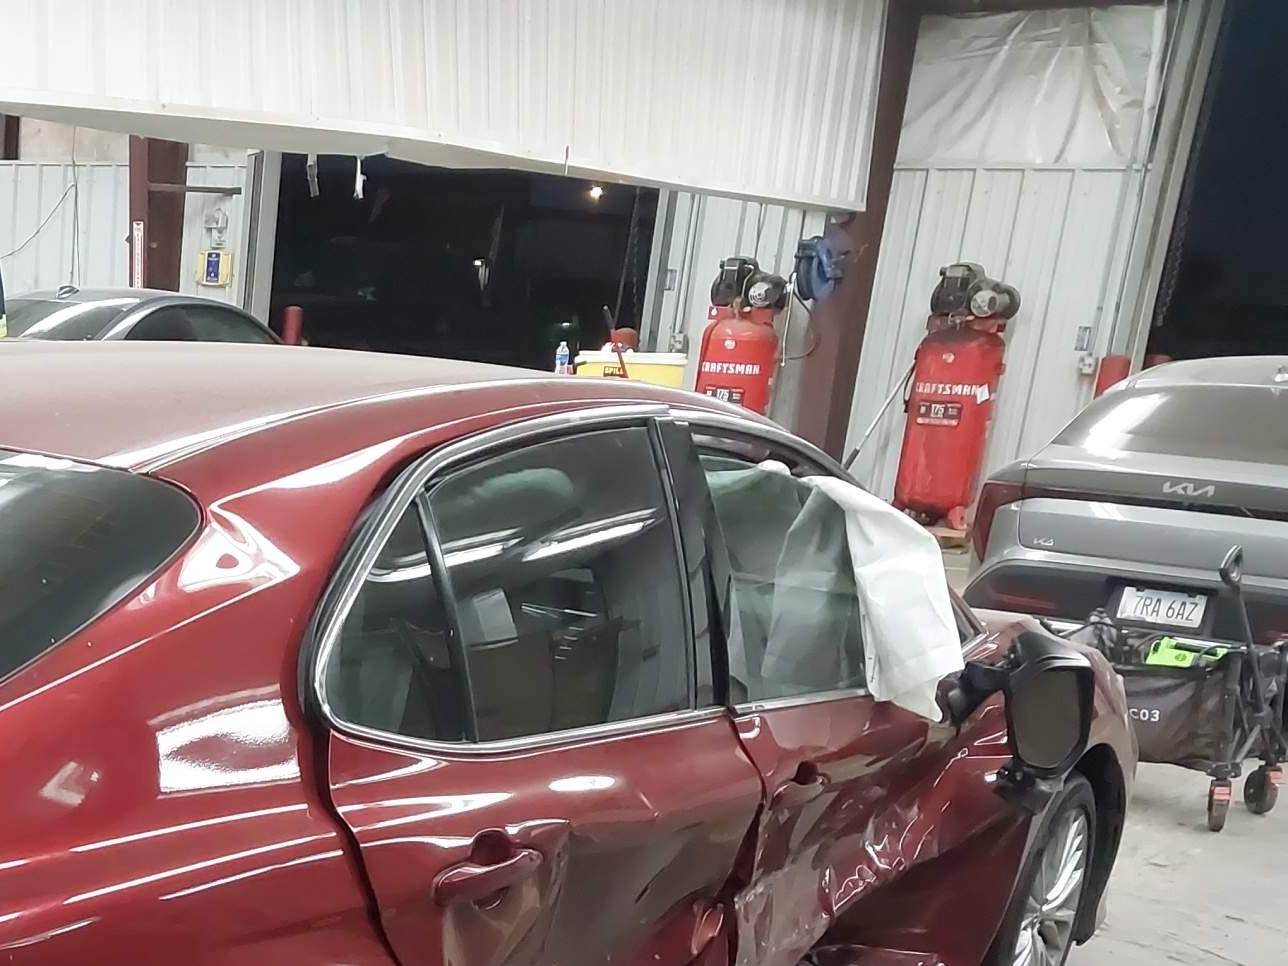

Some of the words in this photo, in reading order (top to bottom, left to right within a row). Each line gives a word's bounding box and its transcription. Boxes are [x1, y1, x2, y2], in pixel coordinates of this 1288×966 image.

[702, 361, 760, 375] CRAFTSMAN
[915, 382, 981, 395] CRAFTSMAN
[931, 403, 945, 414] 175
[1163, 481, 1215, 497] KIA
[1133, 595, 1162, 617] 7RA
[1166, 600, 1199, 621] 6AZ
